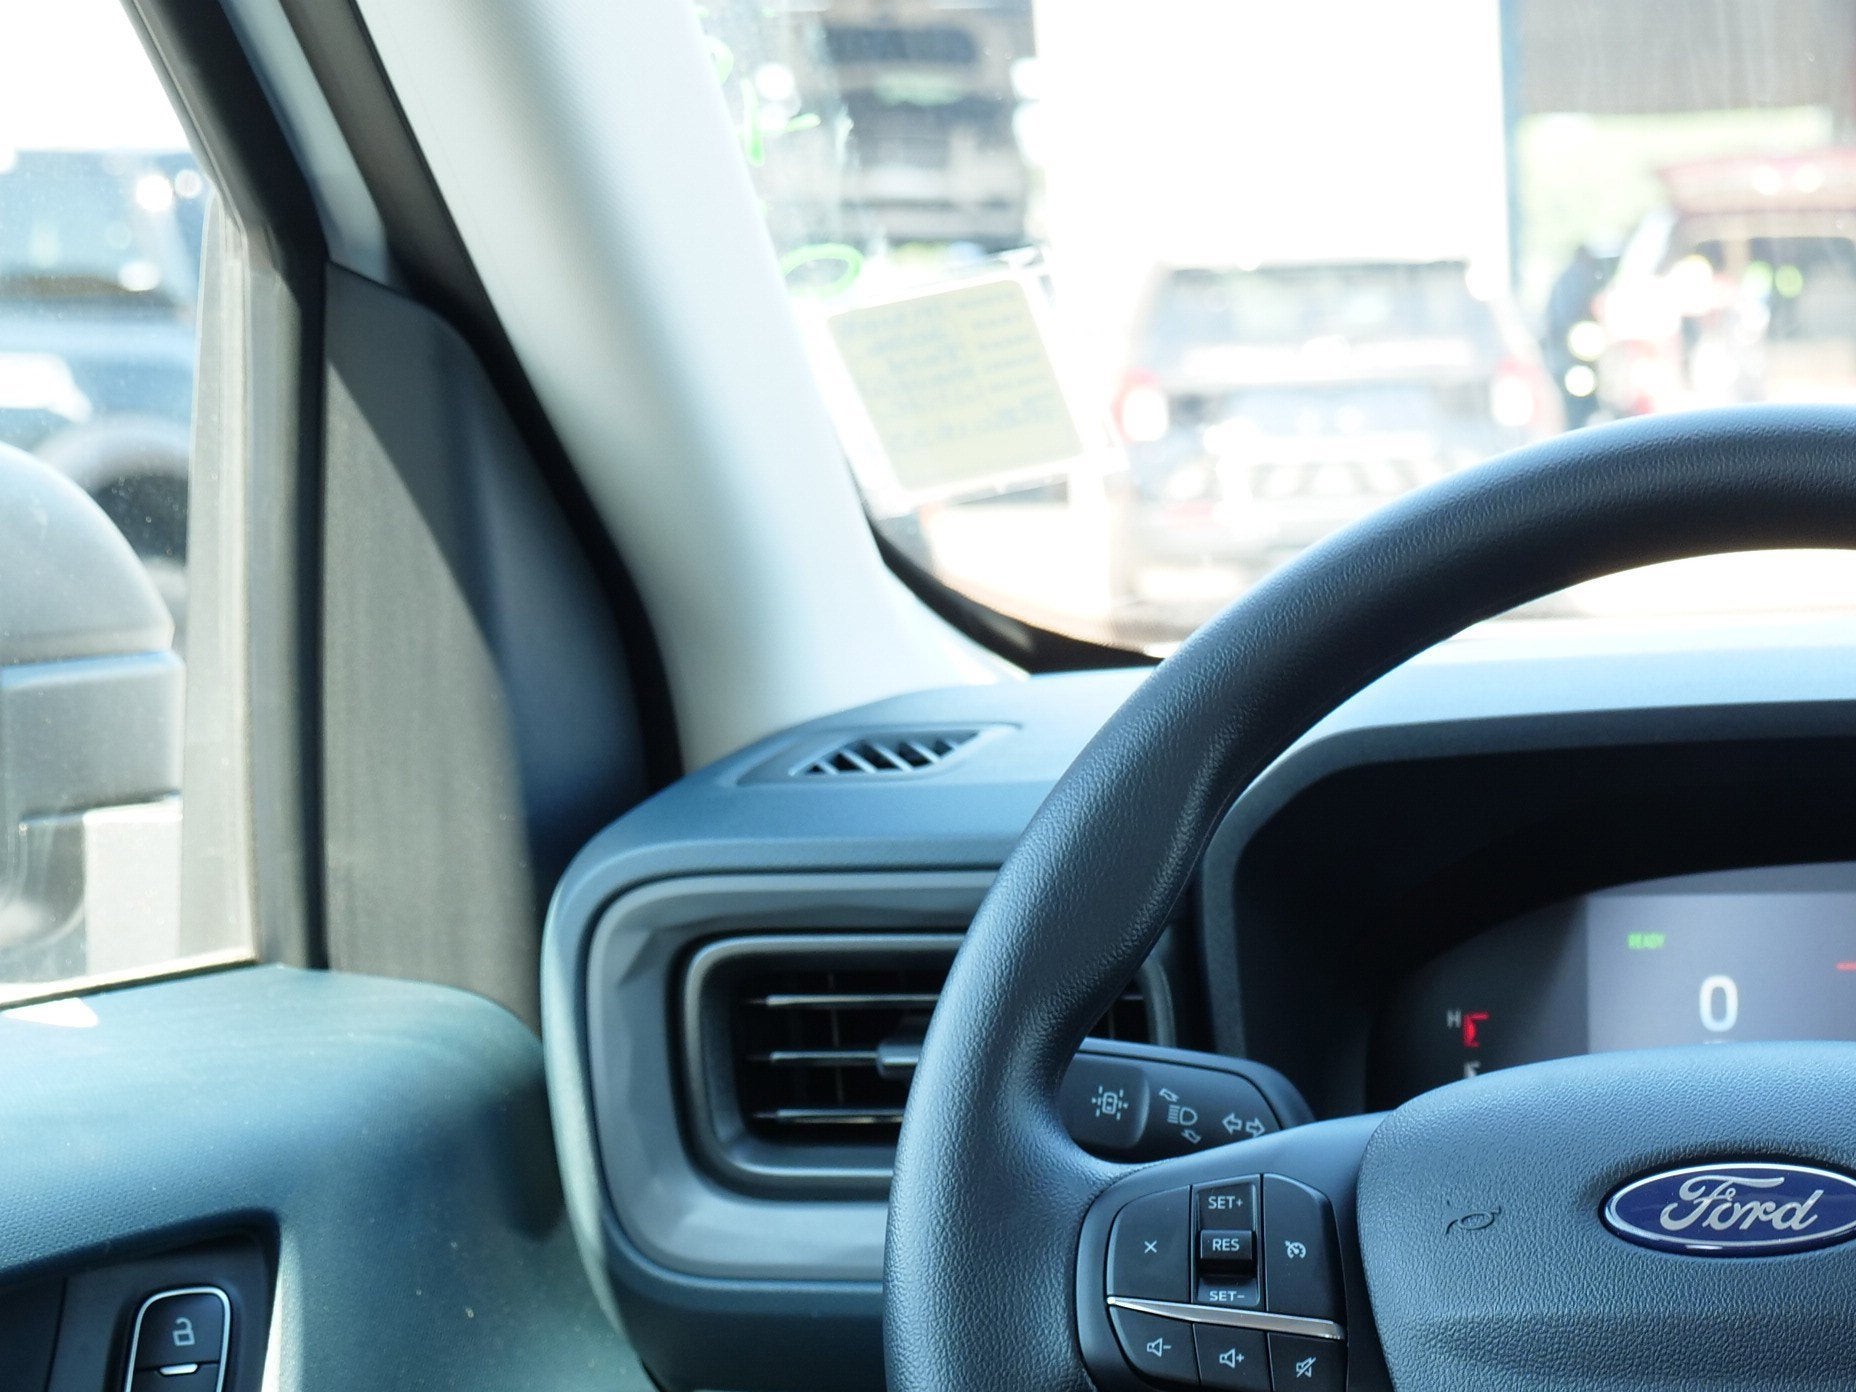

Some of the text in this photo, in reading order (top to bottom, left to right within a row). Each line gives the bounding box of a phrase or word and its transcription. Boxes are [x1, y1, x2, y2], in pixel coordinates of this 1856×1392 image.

[1699, 974, 1739, 1033] 0
[1208, 1196, 1243, 1210] SET+
[1658, 1175, 1825, 1232] Ford
[1212, 1238, 1240, 1252] RES
[1209, 1290, 1245, 1302] SET-
